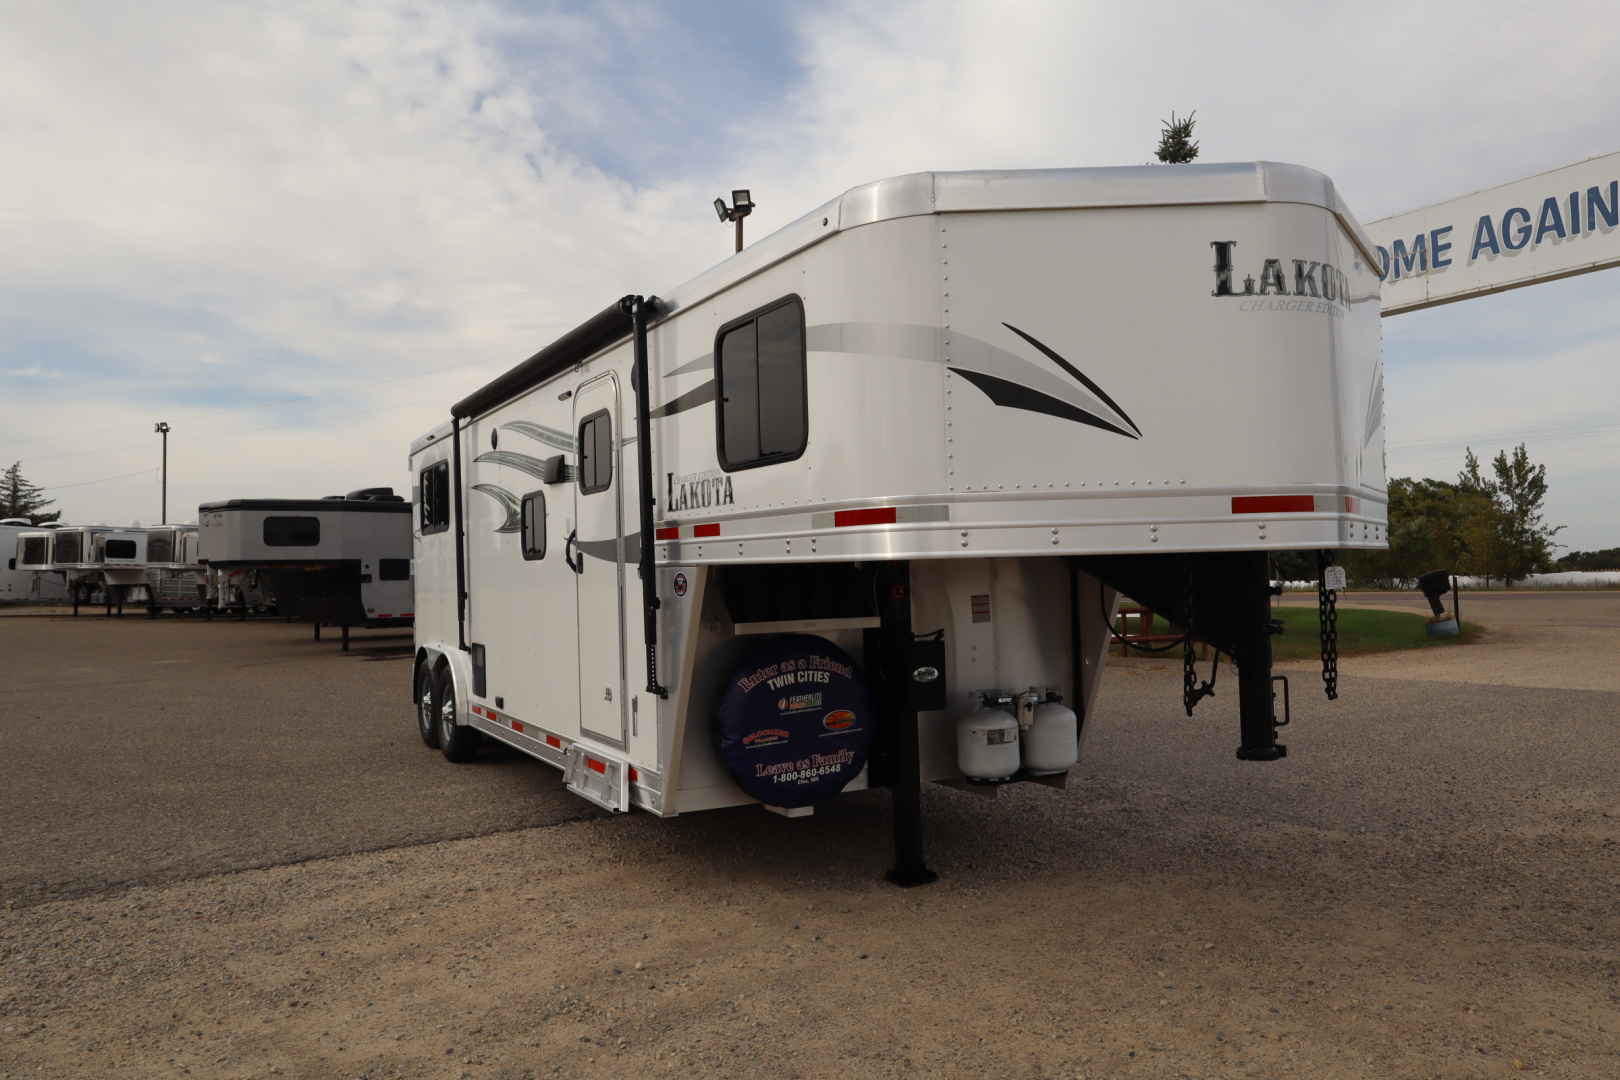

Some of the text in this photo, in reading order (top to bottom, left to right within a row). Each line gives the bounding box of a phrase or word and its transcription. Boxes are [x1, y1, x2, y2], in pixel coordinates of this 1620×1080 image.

[1470, 180, 1619, 261] AGAIN
[1209, 240, 1351, 312] LAKOTA
[1239, 299, 1313, 312] CHARGER
[673, 473, 698, 485] CHARGER
[667, 472, 735, 512] LAKOTA
[737, 655, 852, 693] Enter as a Friend
[766, 671, 830, 691] TWIN CITIES
[789, 692, 822, 704] FEATHERLITE
[756, 749, 855, 777] Leave as Family
[773, 764, 841, 783] 1-800-860-6548
